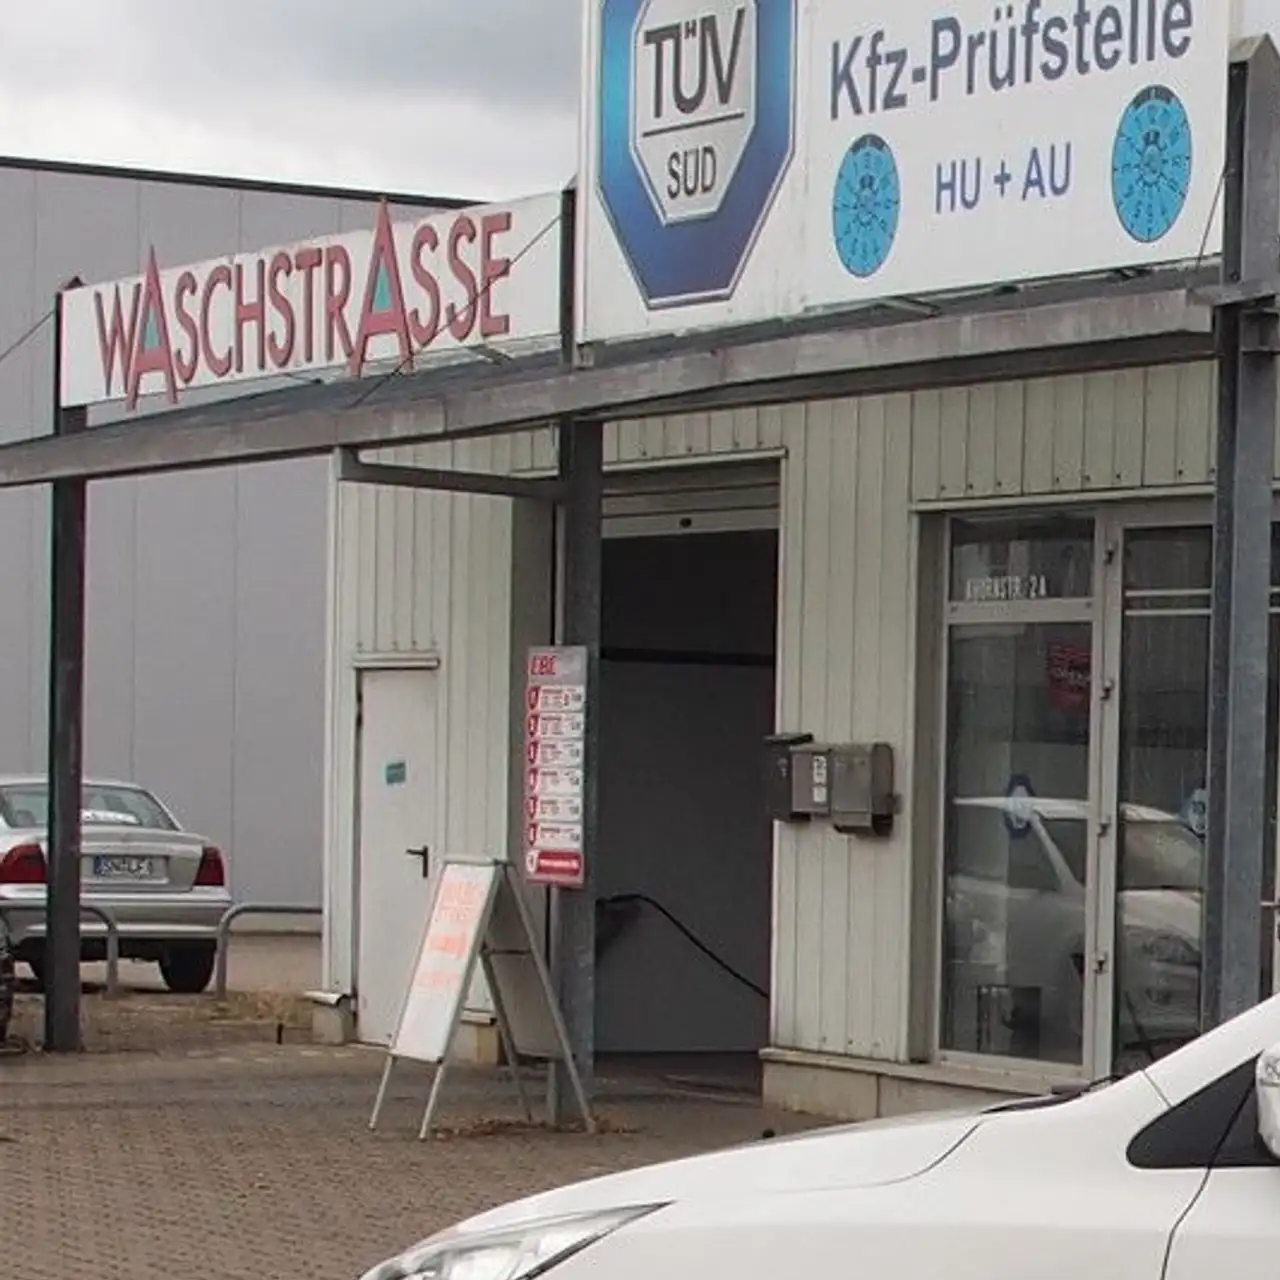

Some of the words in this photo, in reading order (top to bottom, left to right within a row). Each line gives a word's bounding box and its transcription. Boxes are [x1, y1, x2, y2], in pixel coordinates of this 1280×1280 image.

[644, 8, 746, 119] TÜV
[830, 0, 1192, 120] Kfz-Prüfstelle
[667, 146, 717, 199] SÜD
[935, 157, 981, 213] HU
[1022, 142, 1071, 200] AU
[95, 198, 512, 411] WASCHSTRASSE
